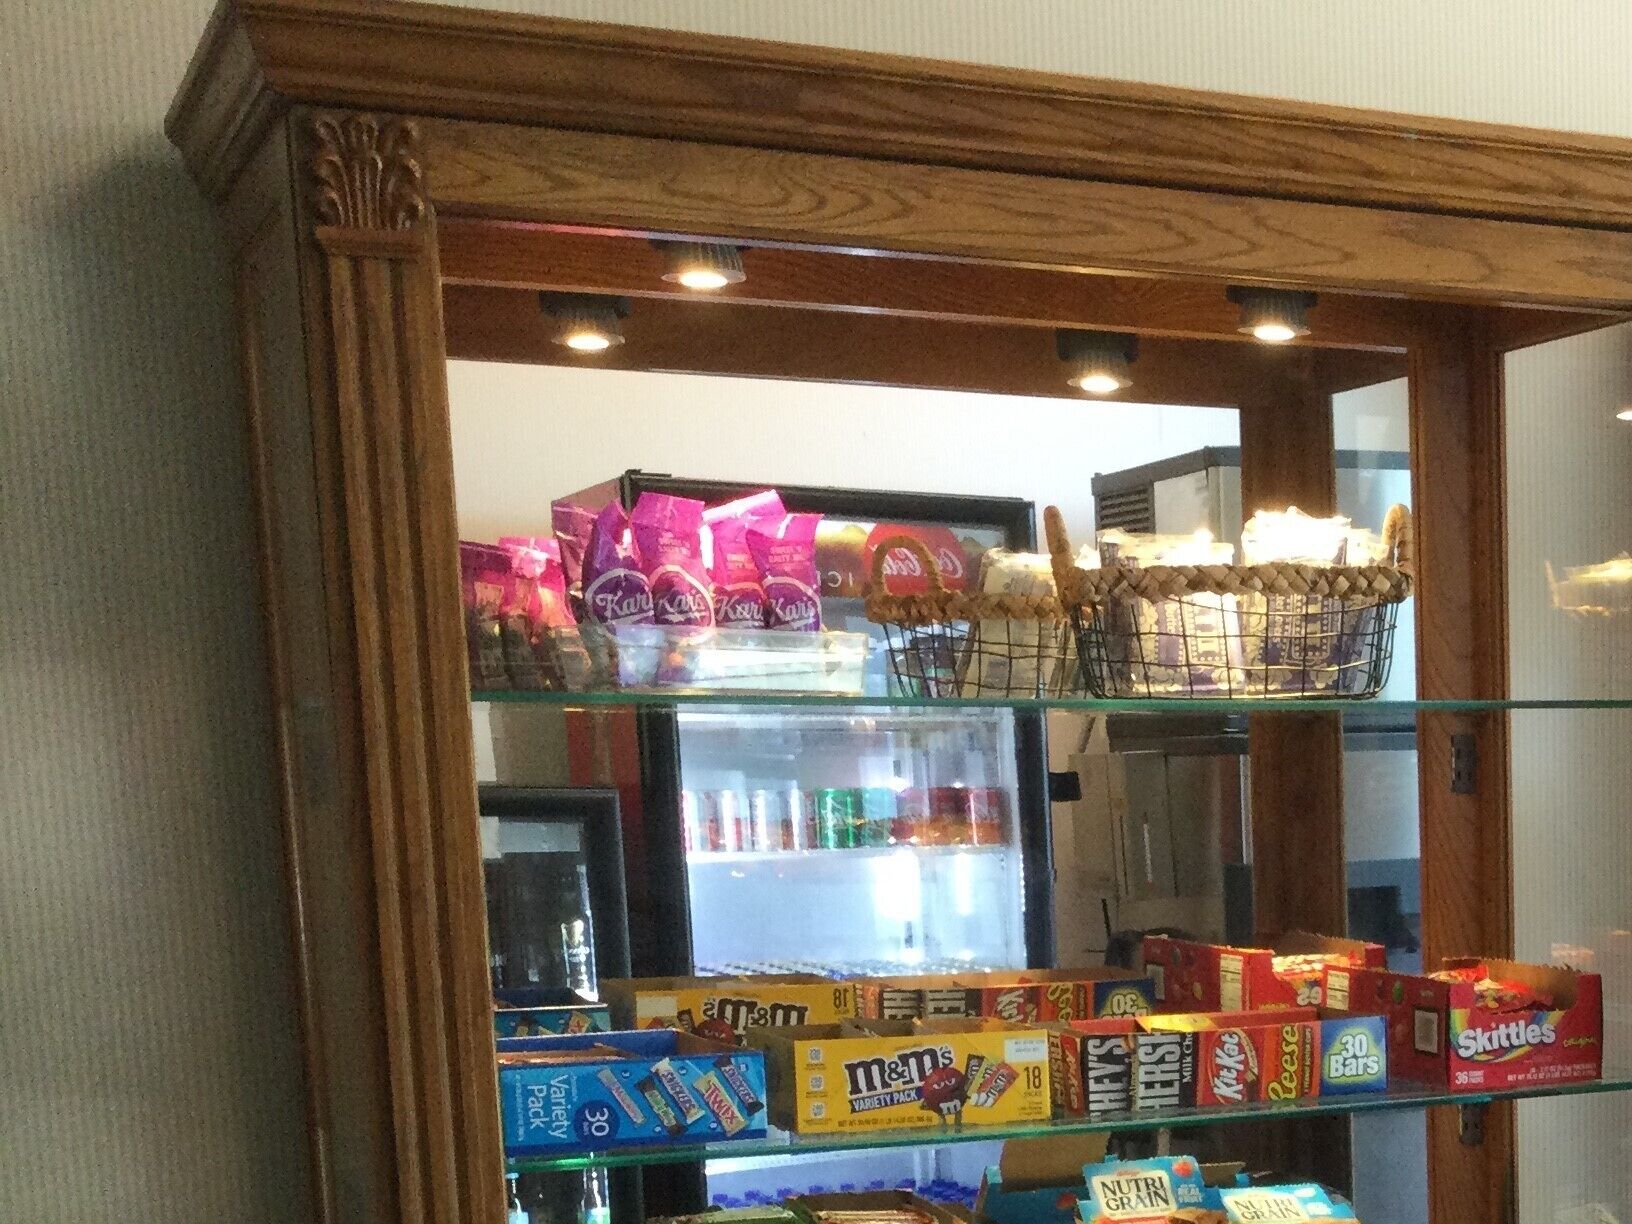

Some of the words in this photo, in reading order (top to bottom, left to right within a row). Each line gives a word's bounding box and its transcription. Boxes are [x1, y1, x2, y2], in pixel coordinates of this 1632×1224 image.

[1341, 1033, 1368, 1058] 30
[1457, 1018, 1557, 1058] Skittles
[1024, 1065, 1042, 1089] 18
[1329, 1054, 1381, 1079] Bars
[1455, 1071, 1469, 1085] 36
[527, 1084, 550, 1130] Pack
[548, 1074, 572, 1139] Variety
[852, 1096, 894, 1112] VARIETY
[893, 1088, 919, 1106] PACK
[585, 1107, 610, 1137] 30
[1100, 1173, 1167, 1199] NUTRI
[1104, 1190, 1170, 1212] GRAIN
[1240, 1205, 1302, 1221] GRAIN
